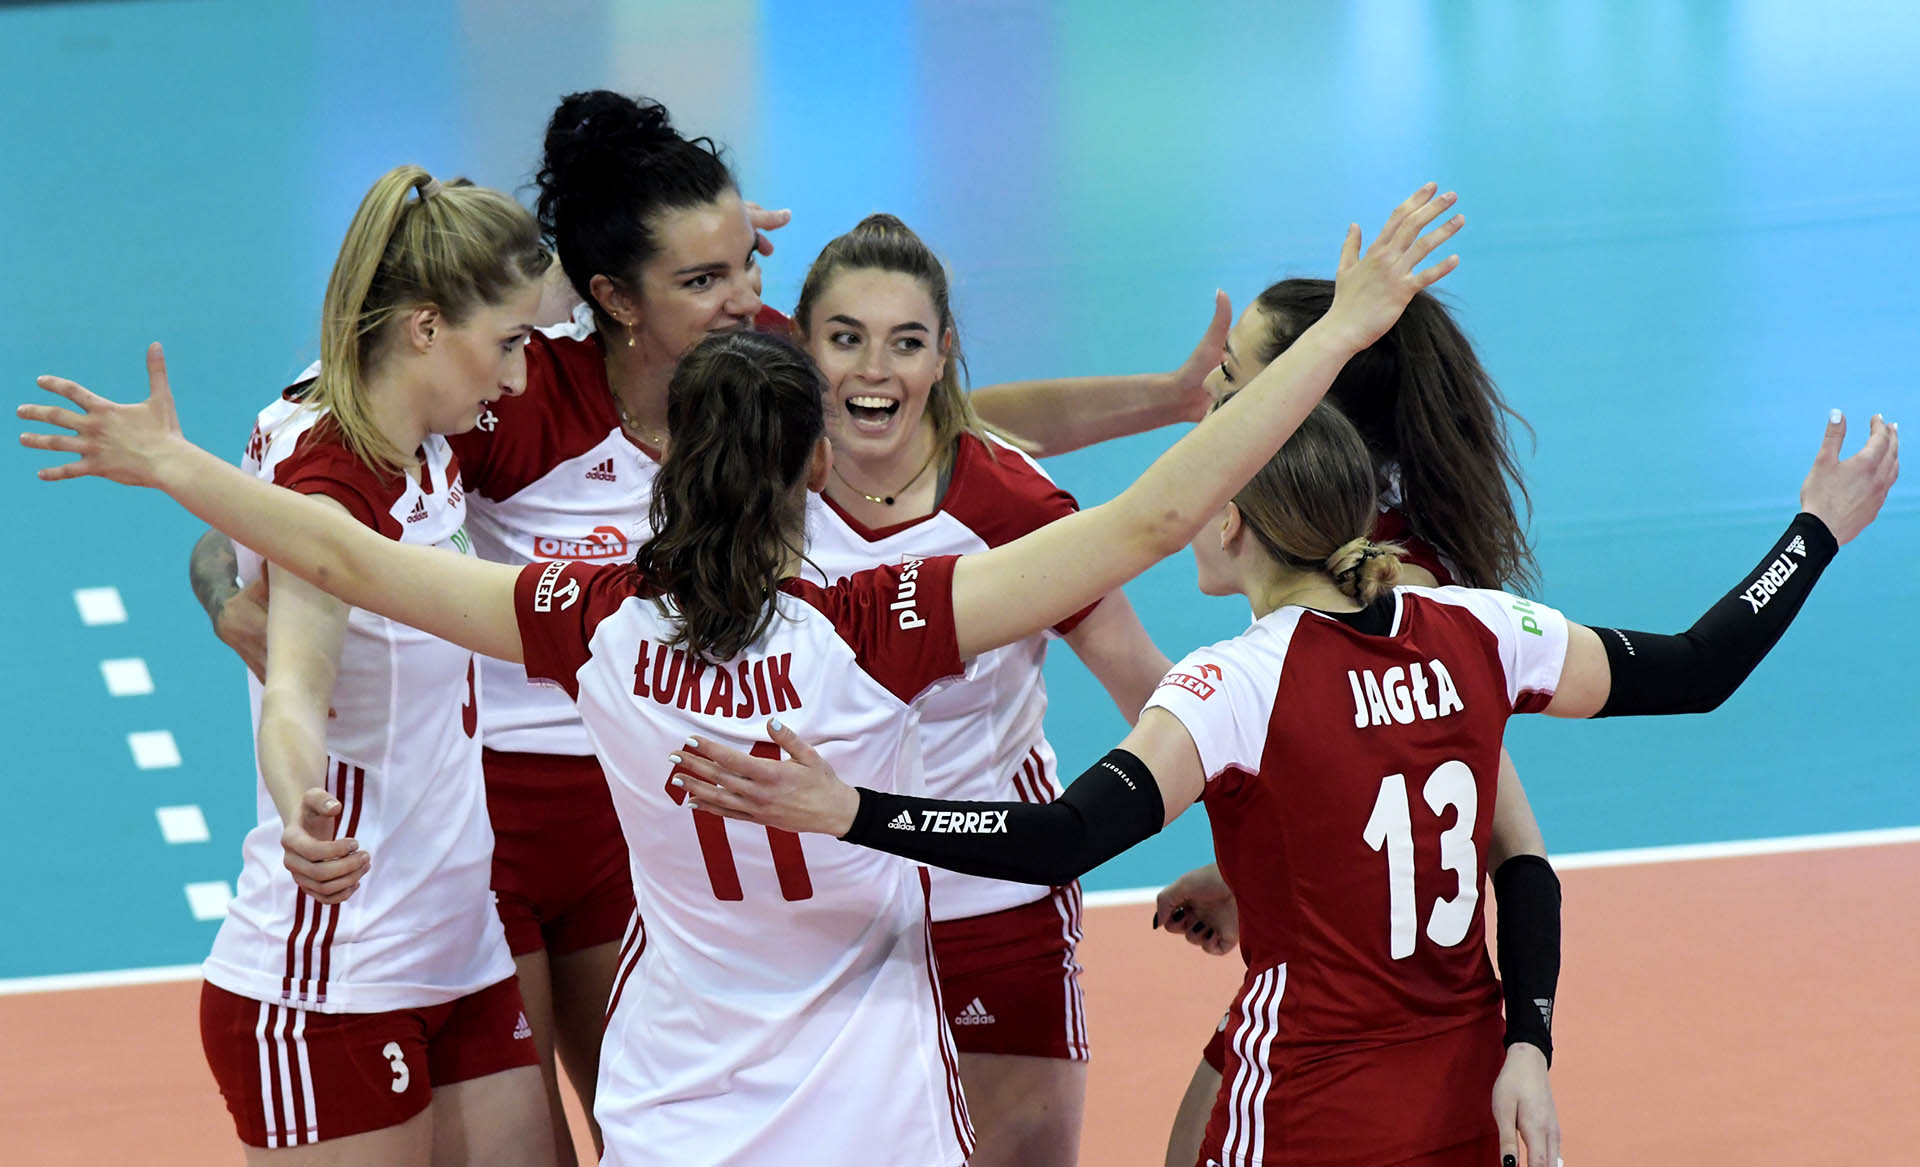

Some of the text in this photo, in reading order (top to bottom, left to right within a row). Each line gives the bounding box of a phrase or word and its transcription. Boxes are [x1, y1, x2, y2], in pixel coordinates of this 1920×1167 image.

[537, 561, 566, 607] ORLEN
[1739, 553, 1799, 614] TERREX
[633, 639, 802, 719] ŁUKASIK
[1347, 658, 1464, 729] JAGŁA
[920, 810, 1009, 833] TERREX
[1362, 760, 1479, 960] 13
[382, 1041, 410, 1093] 3
